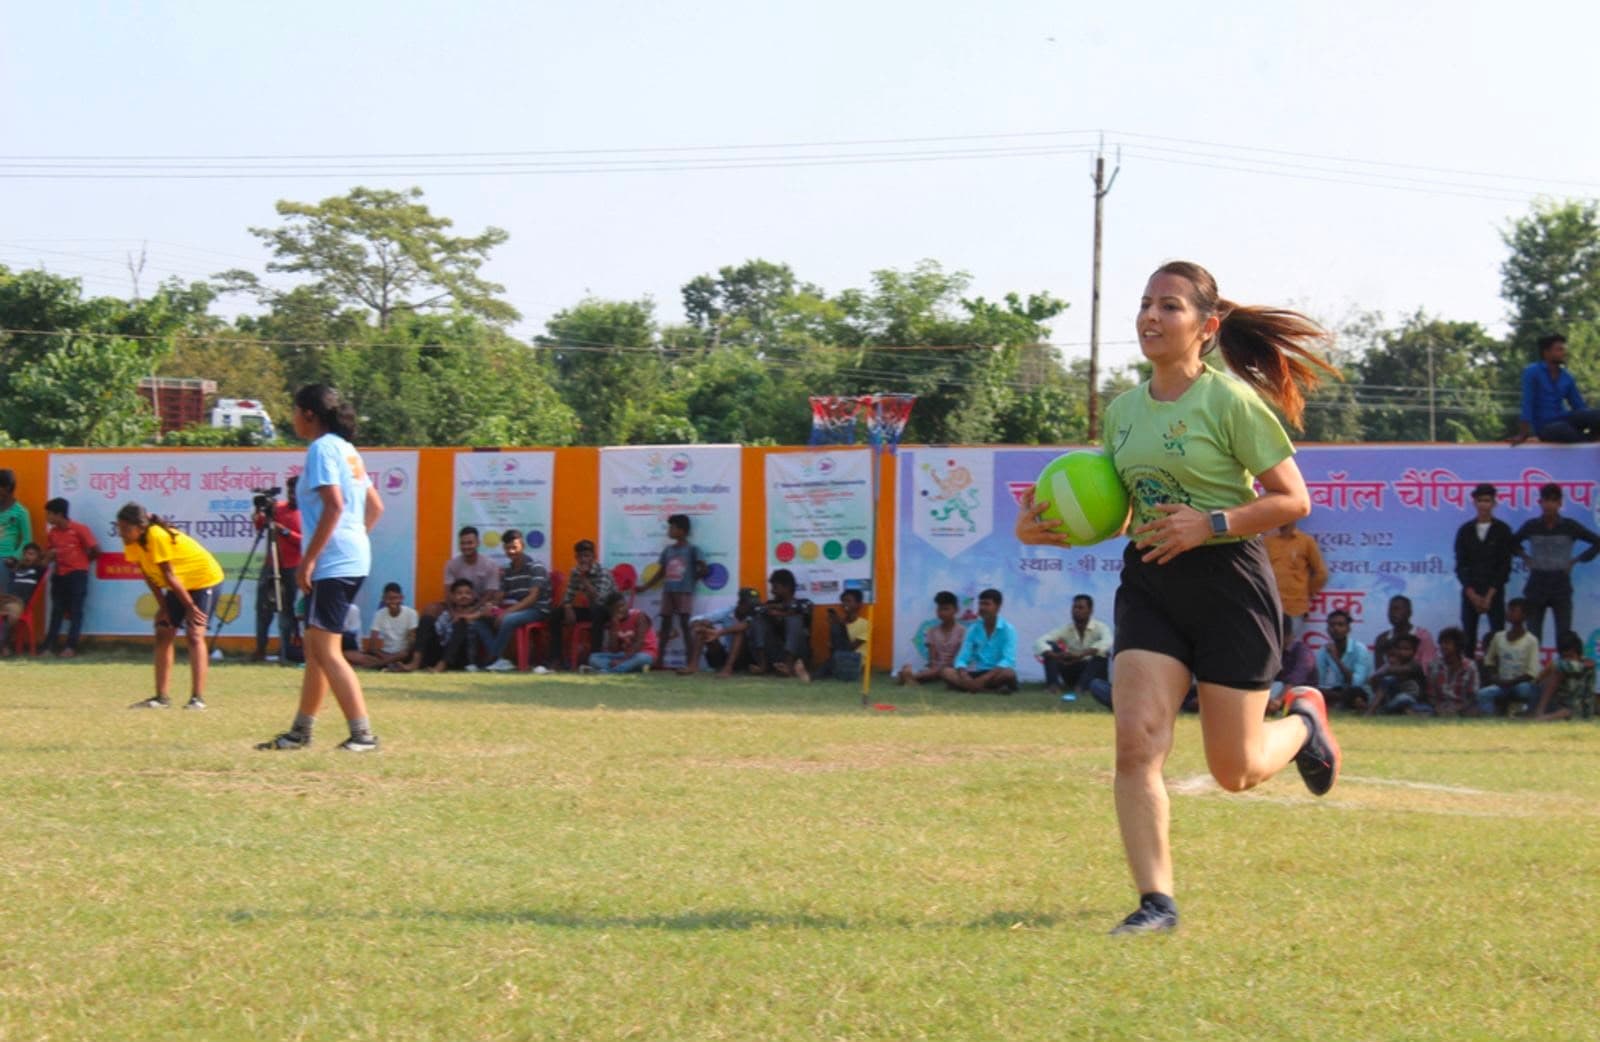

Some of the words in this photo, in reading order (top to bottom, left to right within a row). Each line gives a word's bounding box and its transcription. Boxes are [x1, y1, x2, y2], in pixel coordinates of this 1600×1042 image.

[89, 465, 131, 499] चतुर्थ
[138, 465, 191, 496] राष्ट्रीय
[1306, 472, 1385, 509] बॉल
[195, 513, 254, 539] एसोसि
[1019, 557, 1062, 571] स्थान
[1077, 554, 1096, 571] श्री
